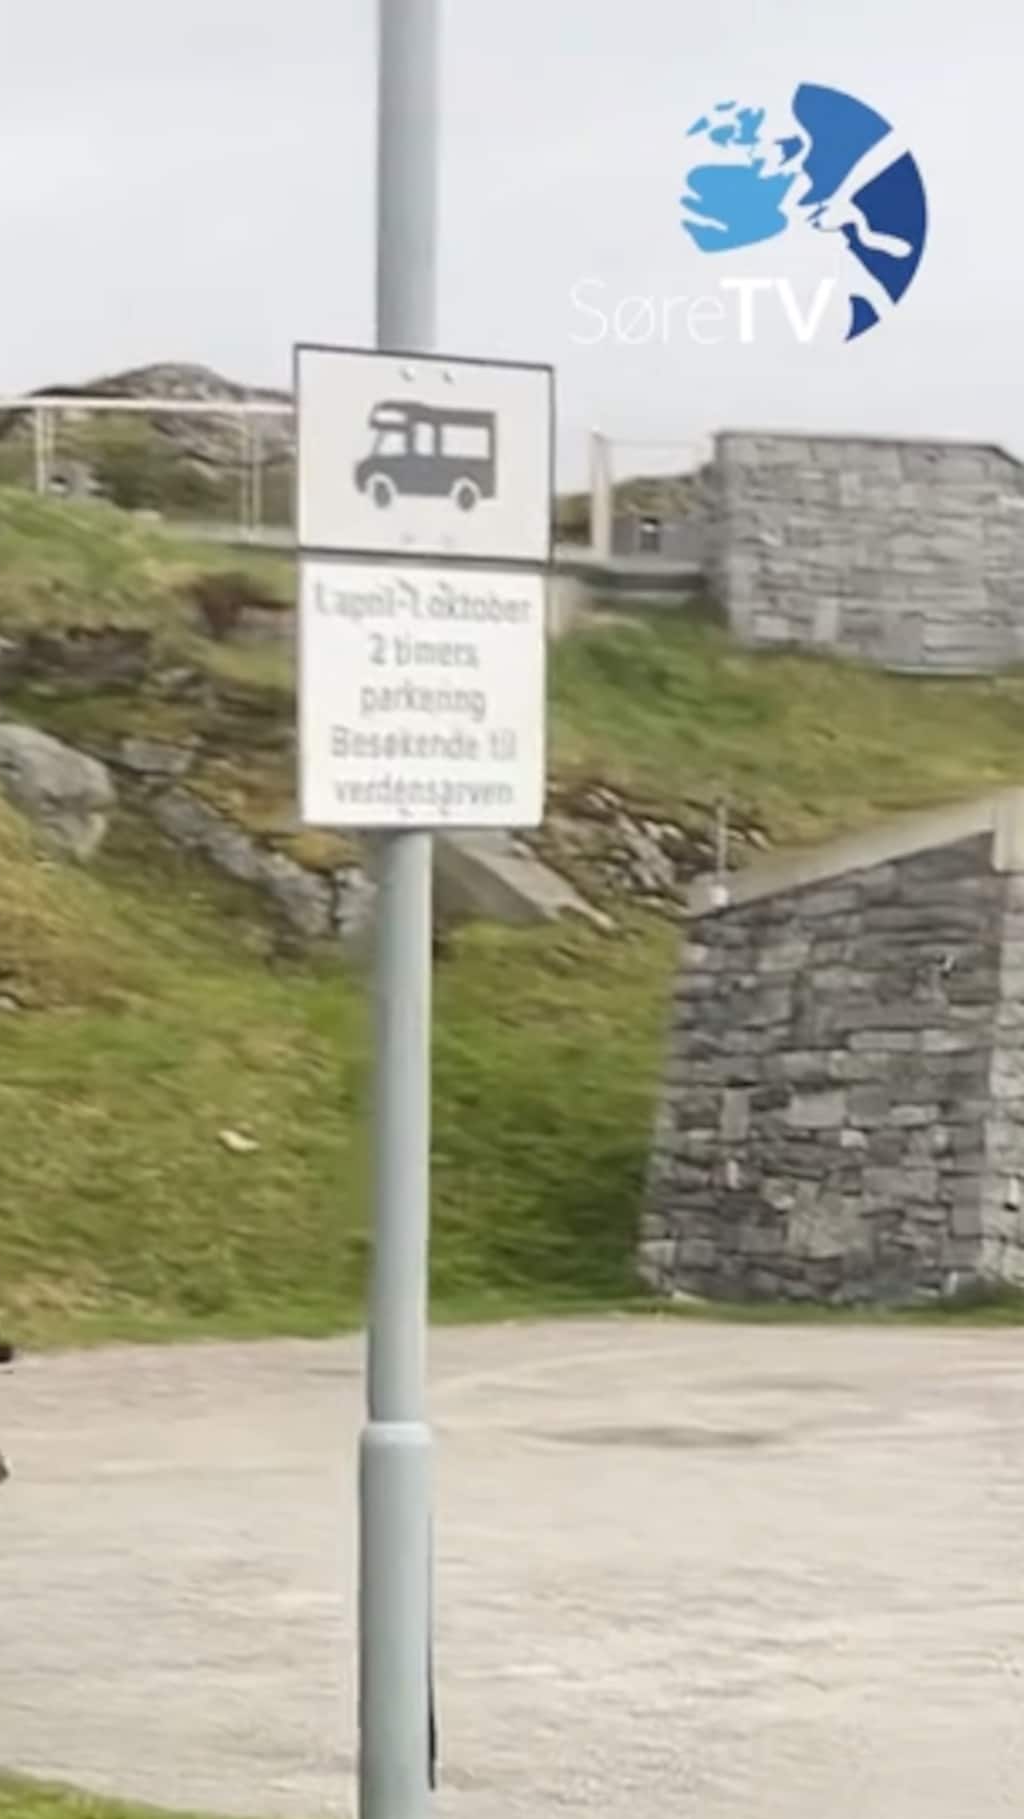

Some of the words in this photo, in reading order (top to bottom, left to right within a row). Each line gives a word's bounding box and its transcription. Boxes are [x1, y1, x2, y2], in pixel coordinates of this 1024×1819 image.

[369, 632, 386, 667] 2
[393, 633, 479, 668] timers
[359, 679, 486, 724] parkering
[330, 724, 479, 761] Besøkende
[489, 729, 517, 761] til
[334, 775, 515, 805] verdensarven
